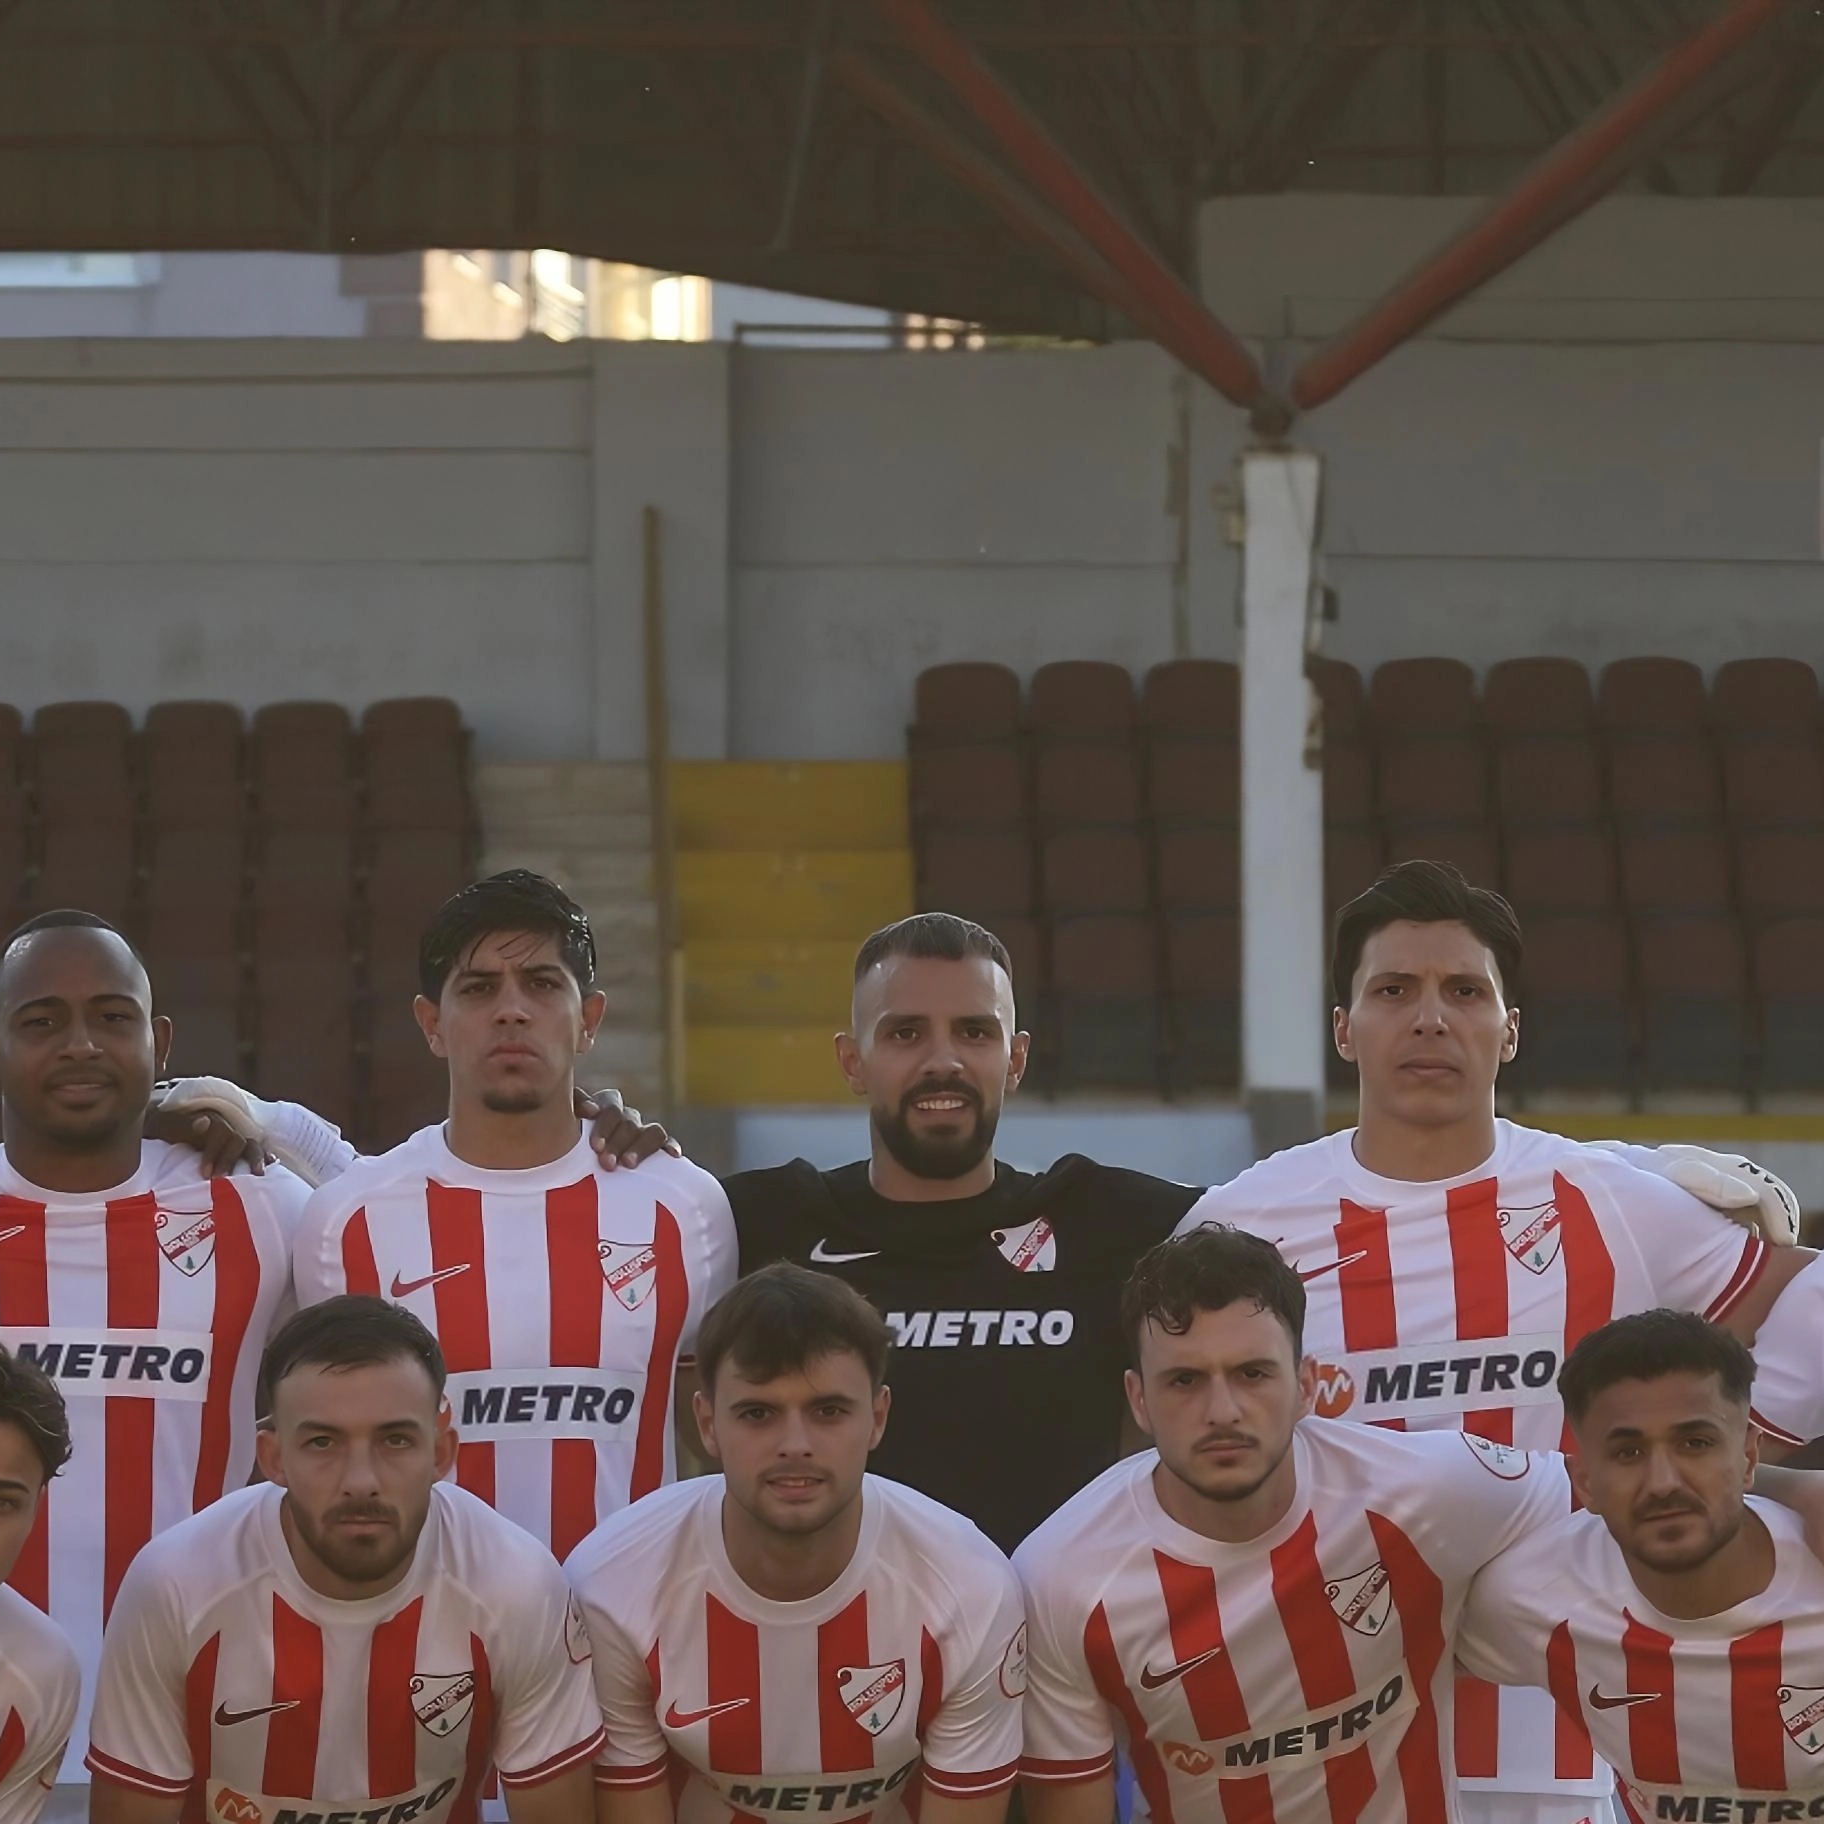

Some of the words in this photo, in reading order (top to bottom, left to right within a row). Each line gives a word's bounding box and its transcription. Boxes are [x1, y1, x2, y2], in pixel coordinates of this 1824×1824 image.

[884, 1309, 1074, 1348] METRO
[15, 1342, 205, 1384] METRO
[1364, 1350, 1557, 1404] METRO
[461, 1385, 635, 1425] METRO
[1224, 1675, 1404, 1767] METRO
[729, 1757, 918, 1812] METRO
